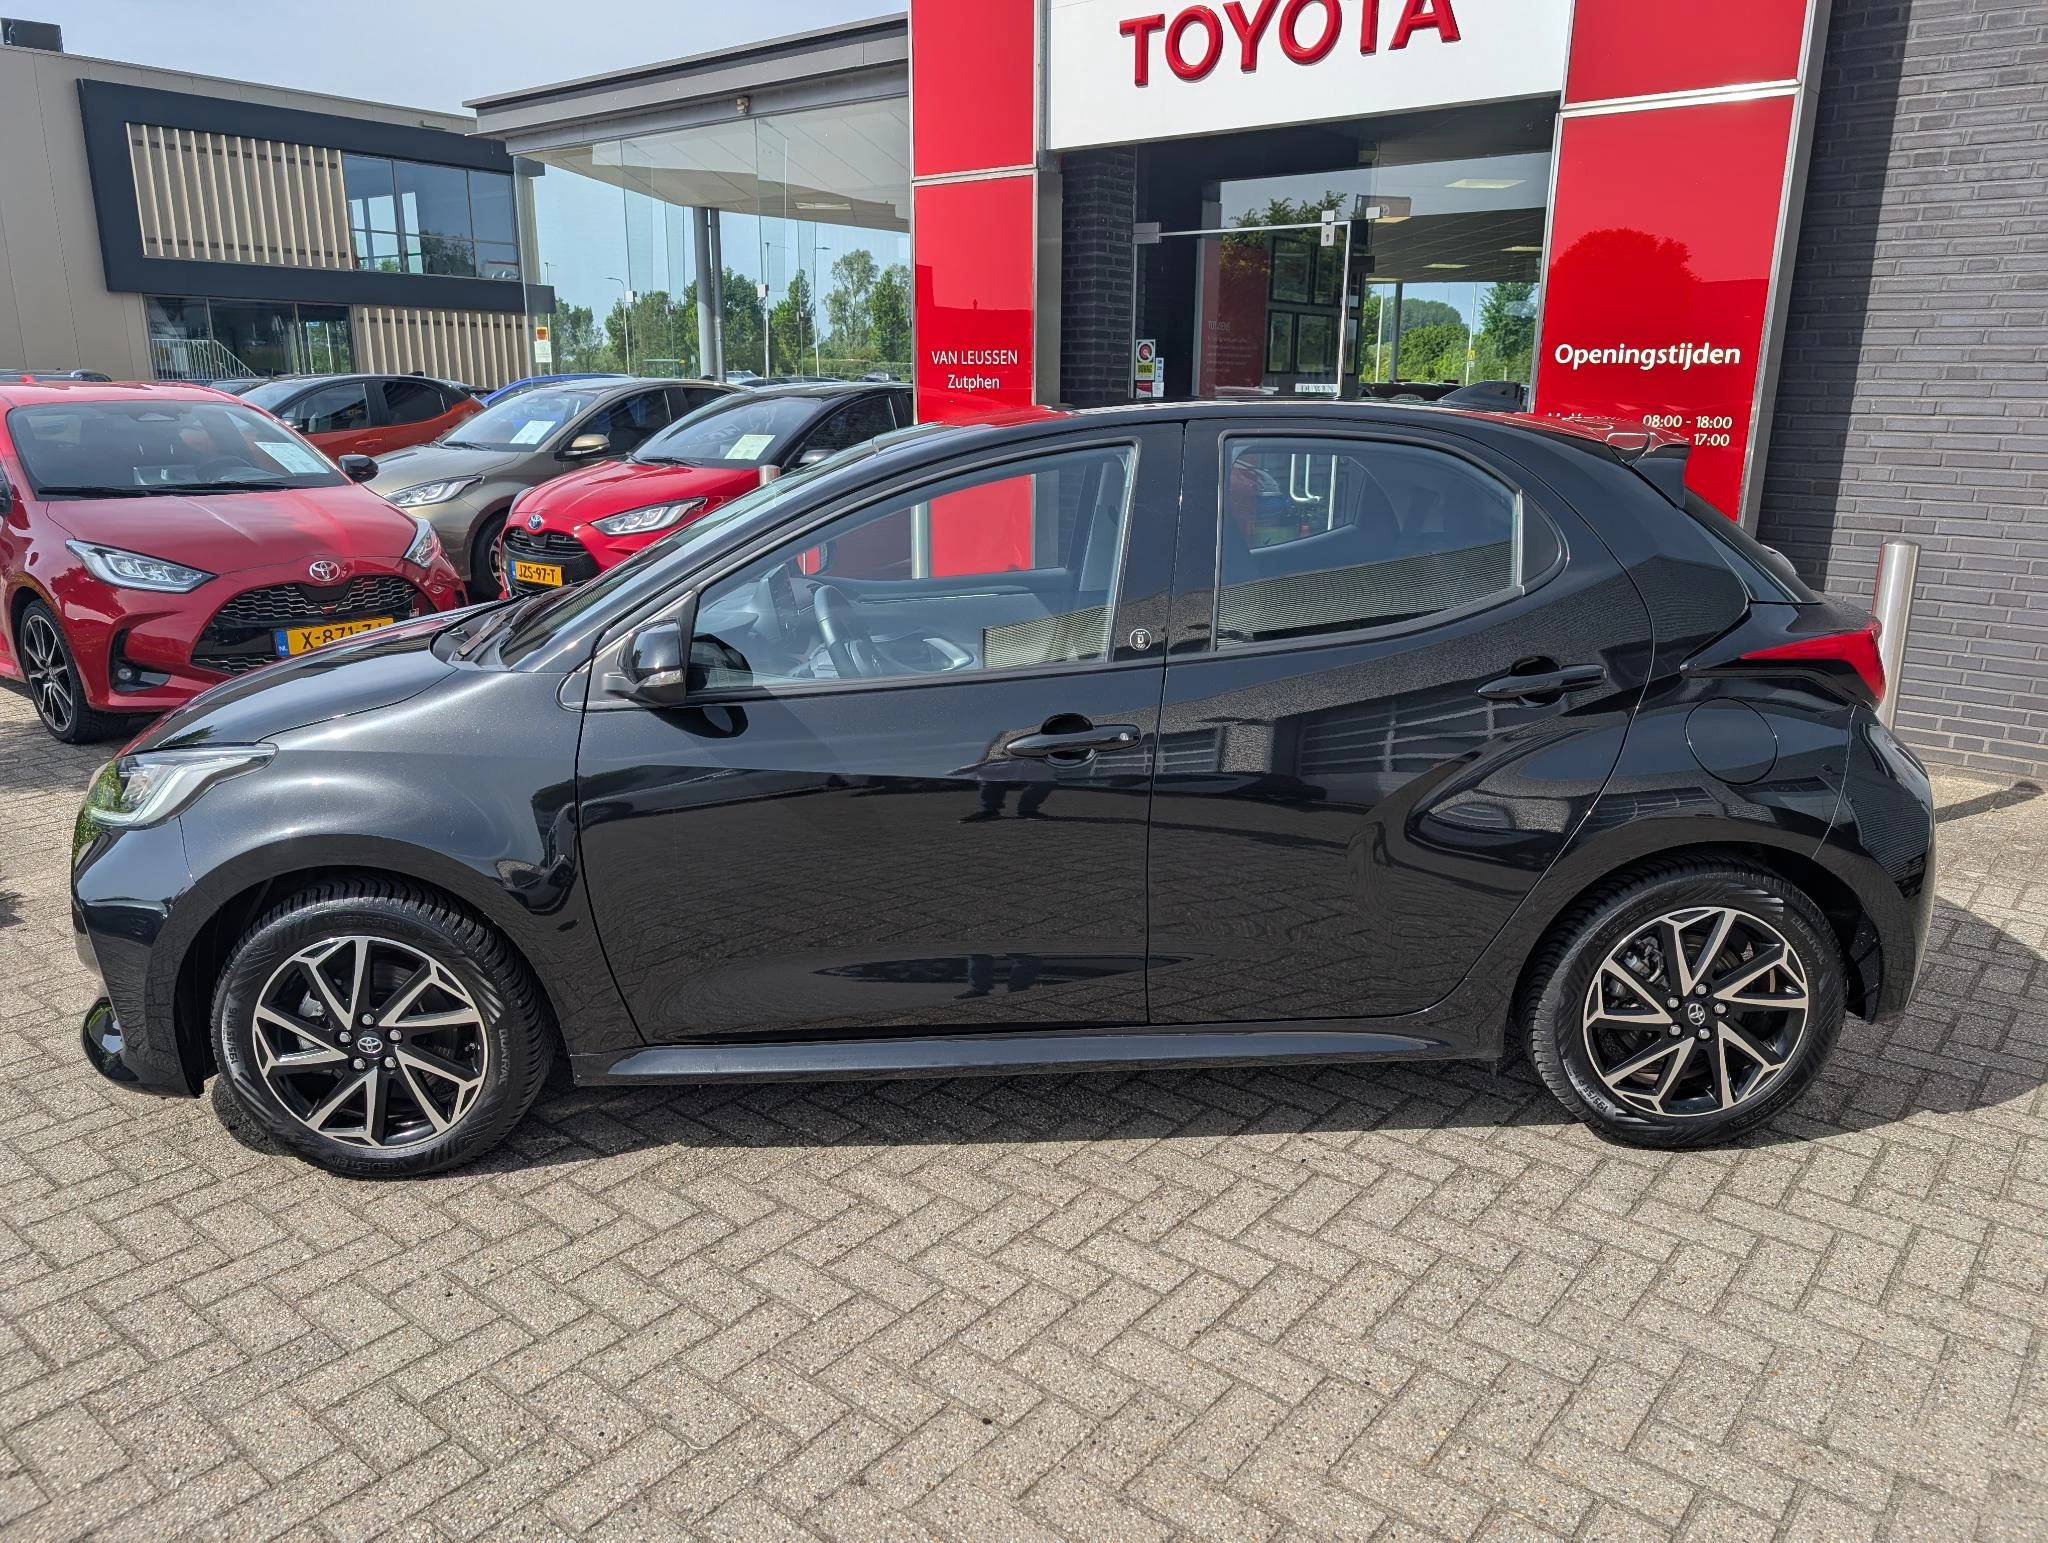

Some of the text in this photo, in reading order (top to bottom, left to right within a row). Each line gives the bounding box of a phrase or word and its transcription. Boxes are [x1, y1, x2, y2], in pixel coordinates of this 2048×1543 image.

[1119, 0, 1461, 88] TOYOTA
[931, 350, 1018, 365] VAN LEUSSEN
[1554, 342, 1741, 371] Openingstijden
[947, 373, 1000, 392] Zutphen
[1642, 414, 1683, 428] 08:00
[1695, 415, 1733, 429] 18:00
[1693, 433, 1730, 446] 17:00
[519, 564, 556, 583] JZS-97-T
